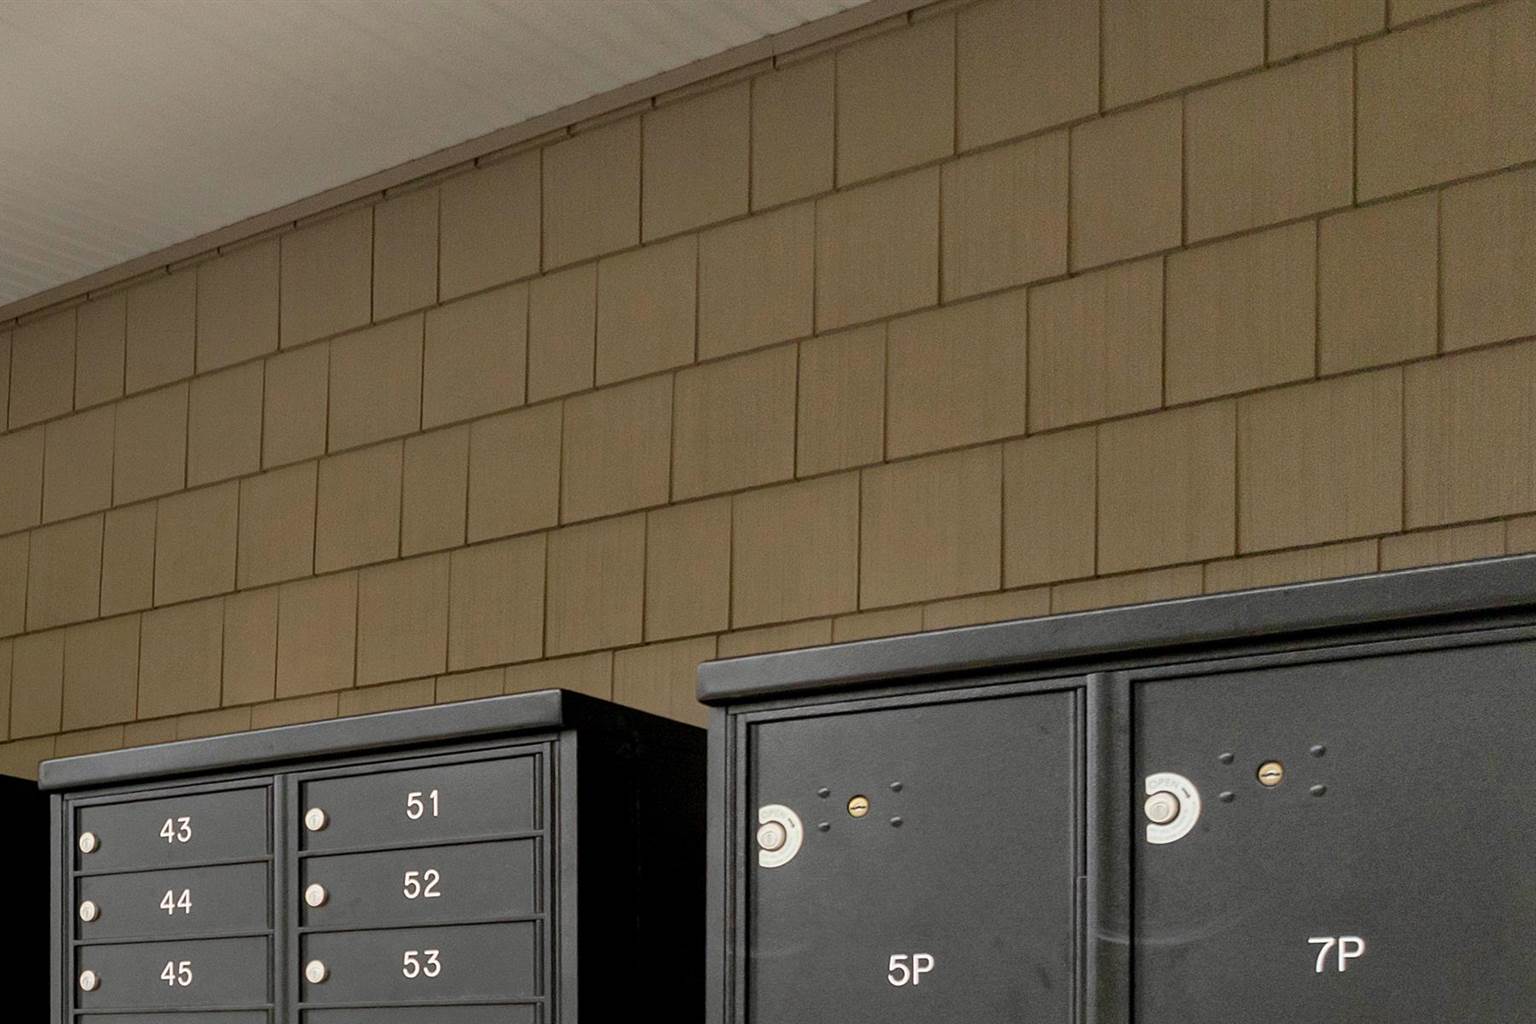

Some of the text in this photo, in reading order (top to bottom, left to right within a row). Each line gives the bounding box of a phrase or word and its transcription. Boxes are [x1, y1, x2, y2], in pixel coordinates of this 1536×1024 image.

[406, 788, 439, 820] 51
[159, 815, 193, 844] 43
[403, 868, 442, 900] 52
[159, 888, 193, 916] 44
[402, 948, 442, 979] 53
[887, 952, 935, 987] 5P
[1307, 935, 1366, 973] 7P
[160, 960, 194, 987] 45
